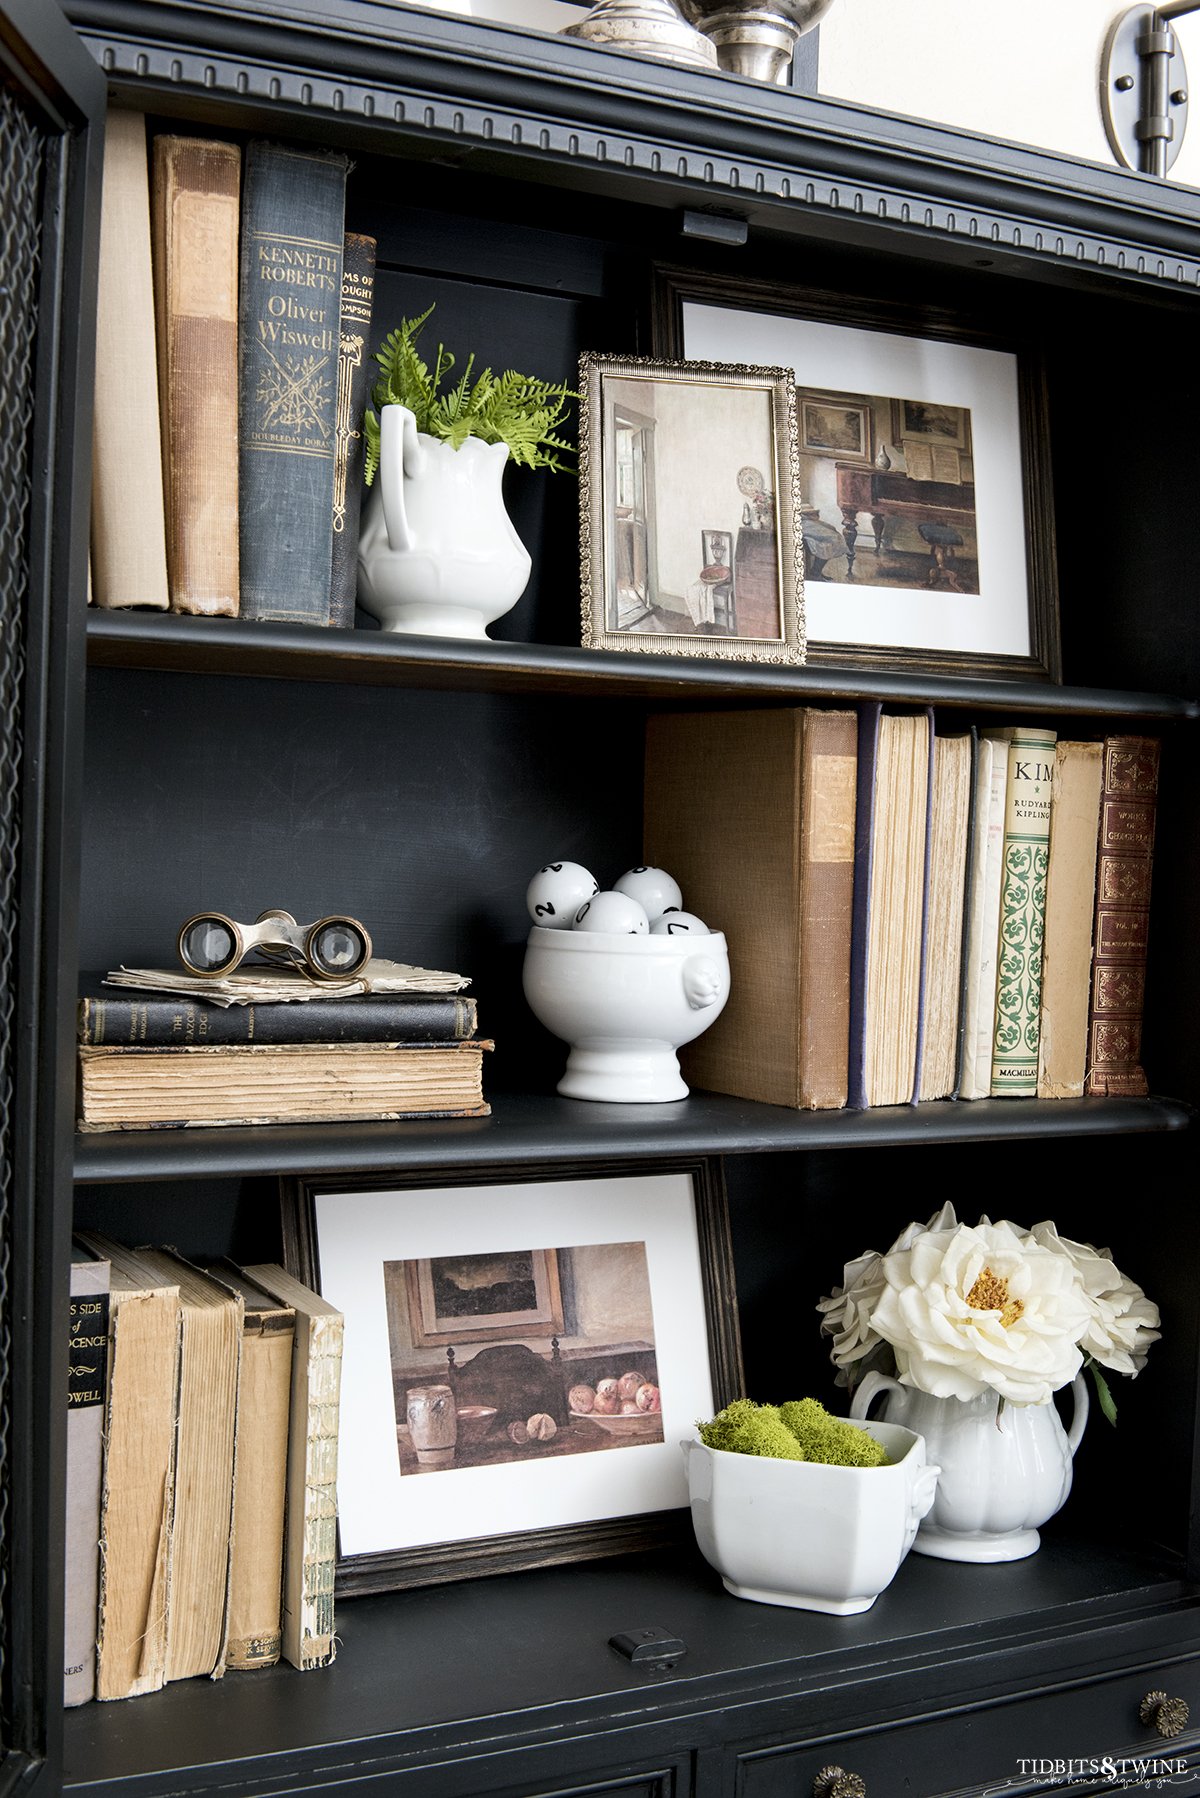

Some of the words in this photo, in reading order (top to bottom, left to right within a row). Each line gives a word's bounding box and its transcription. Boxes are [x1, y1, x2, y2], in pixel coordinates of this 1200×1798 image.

[258, 246, 337, 273] KENNETH
[260, 265, 336, 292] ROBERTS
[342, 272, 358, 283] MS
[361, 275, 374, 286] OF
[341, 284, 373, 300] OUGHT
[268, 295, 326, 323] Oliver
[340, 303, 372, 317] OMPSON
[258, 320, 332, 351] Wiswell
[251, 431, 302, 444] DOUBLEDAY
[1014, 761, 1054, 782] KIM
[1014, 799, 1052, 809] RUDYARD
[1016, 810, 1050, 820] KIPLING
[1118, 811, 1147, 822] WORKS
[173, 1014, 183, 1031] THE
[199, 1012, 208, 1035] EDGE
[999, 1069, 1038, 1077] MACMILLAN
[79, 1303, 102, 1315] SIDE
[72, 1320, 82, 1334] of
[69, 1336, 106, 1348] CENCE
